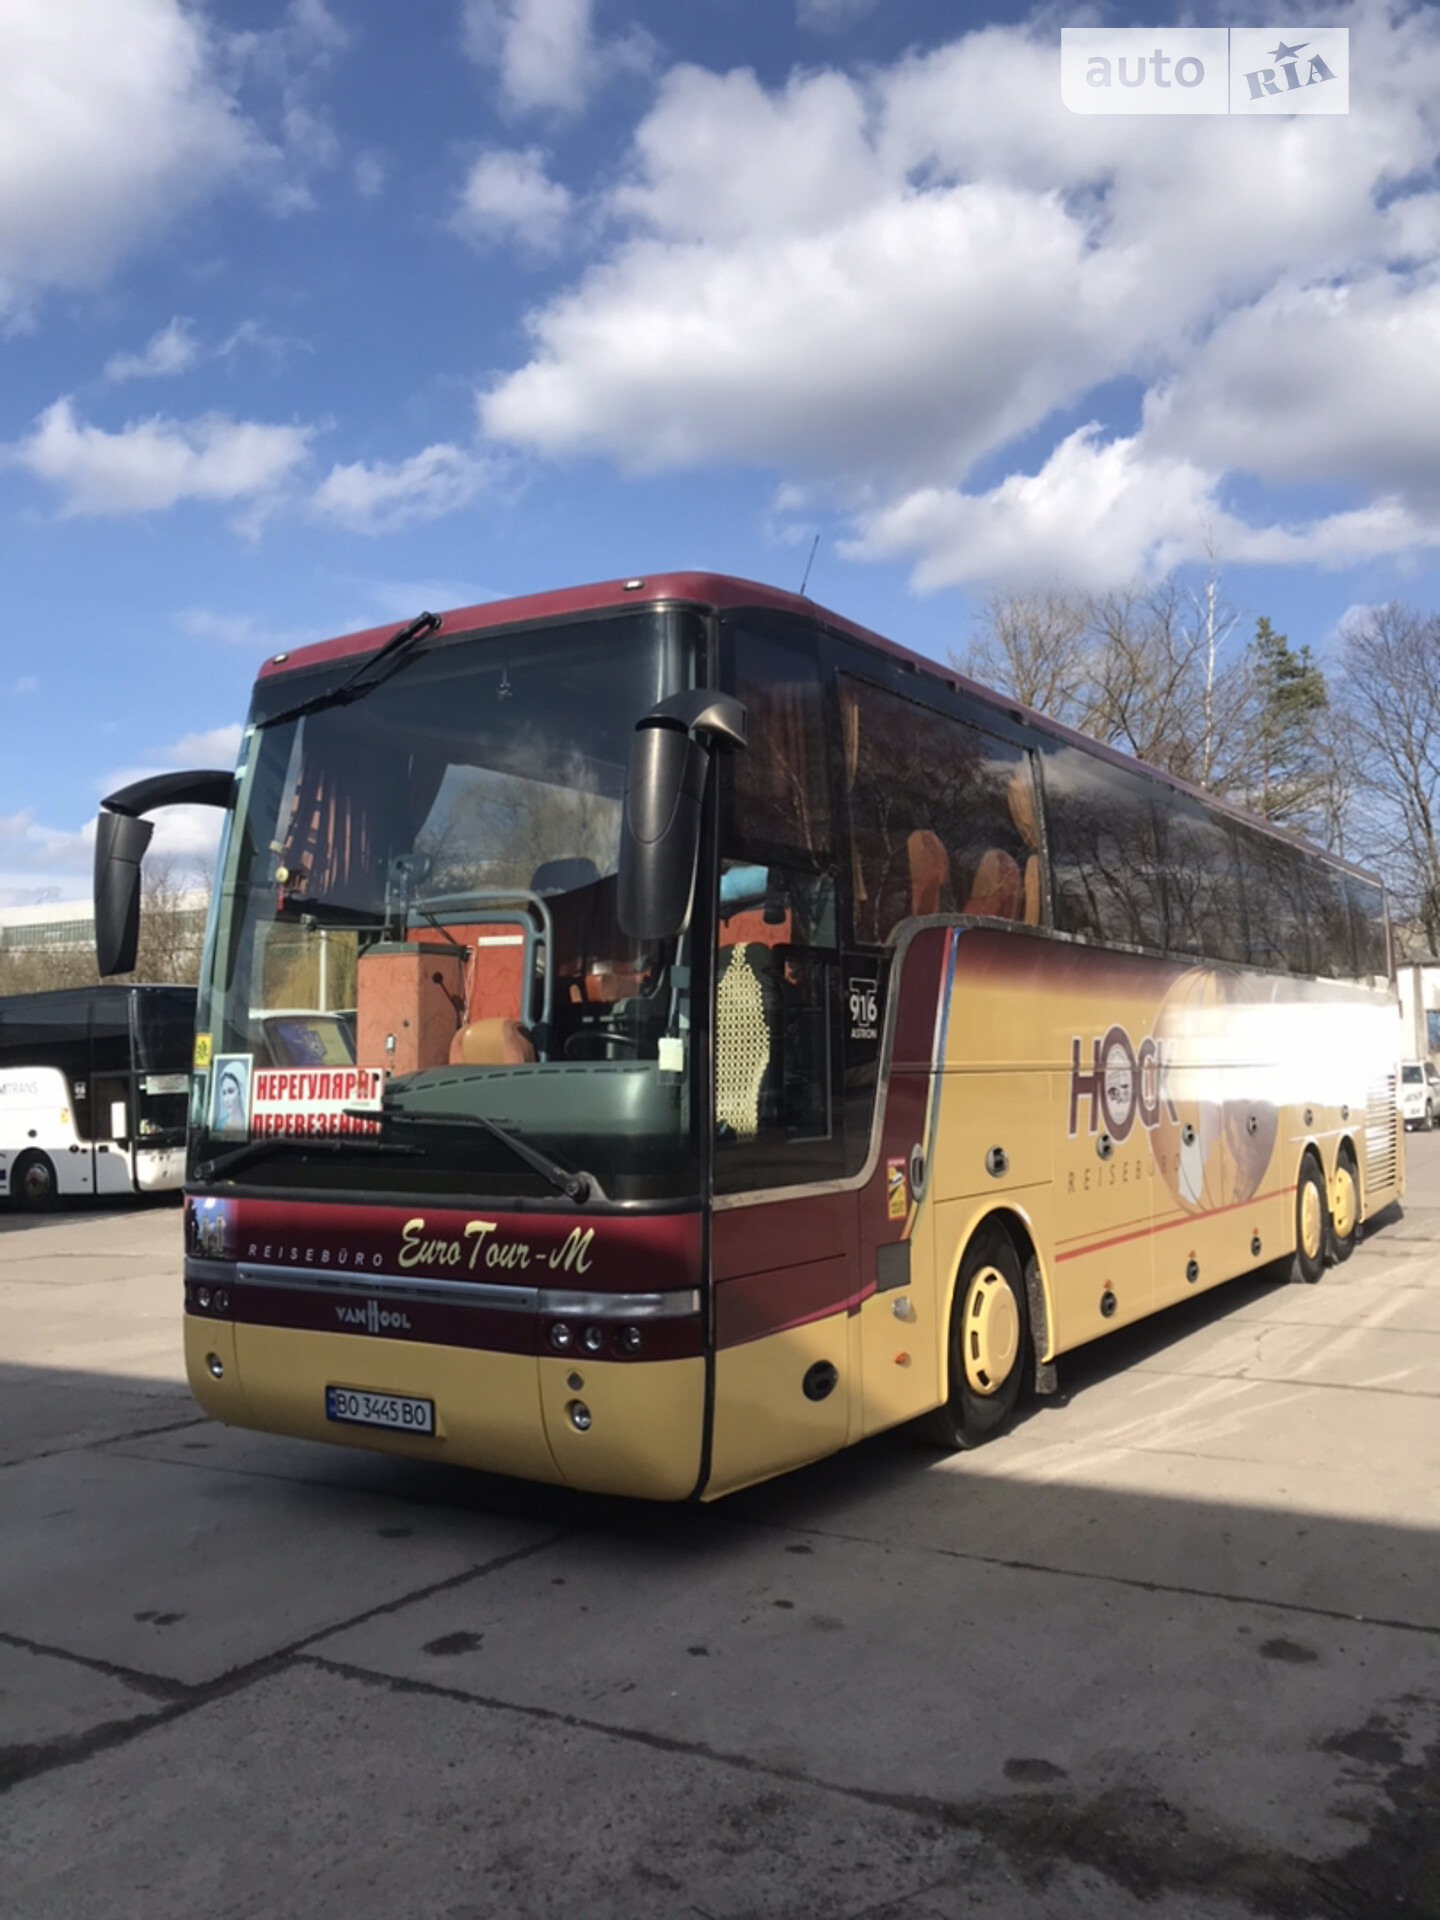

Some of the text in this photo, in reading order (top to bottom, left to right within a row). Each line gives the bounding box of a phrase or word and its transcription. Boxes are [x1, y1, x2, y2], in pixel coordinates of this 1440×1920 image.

[247, 1243, 384, 1268] REISEBÜRO
[397, 1217, 463, 1268] Euro
[336, 1393, 427, 1426] BO 3445 BO
